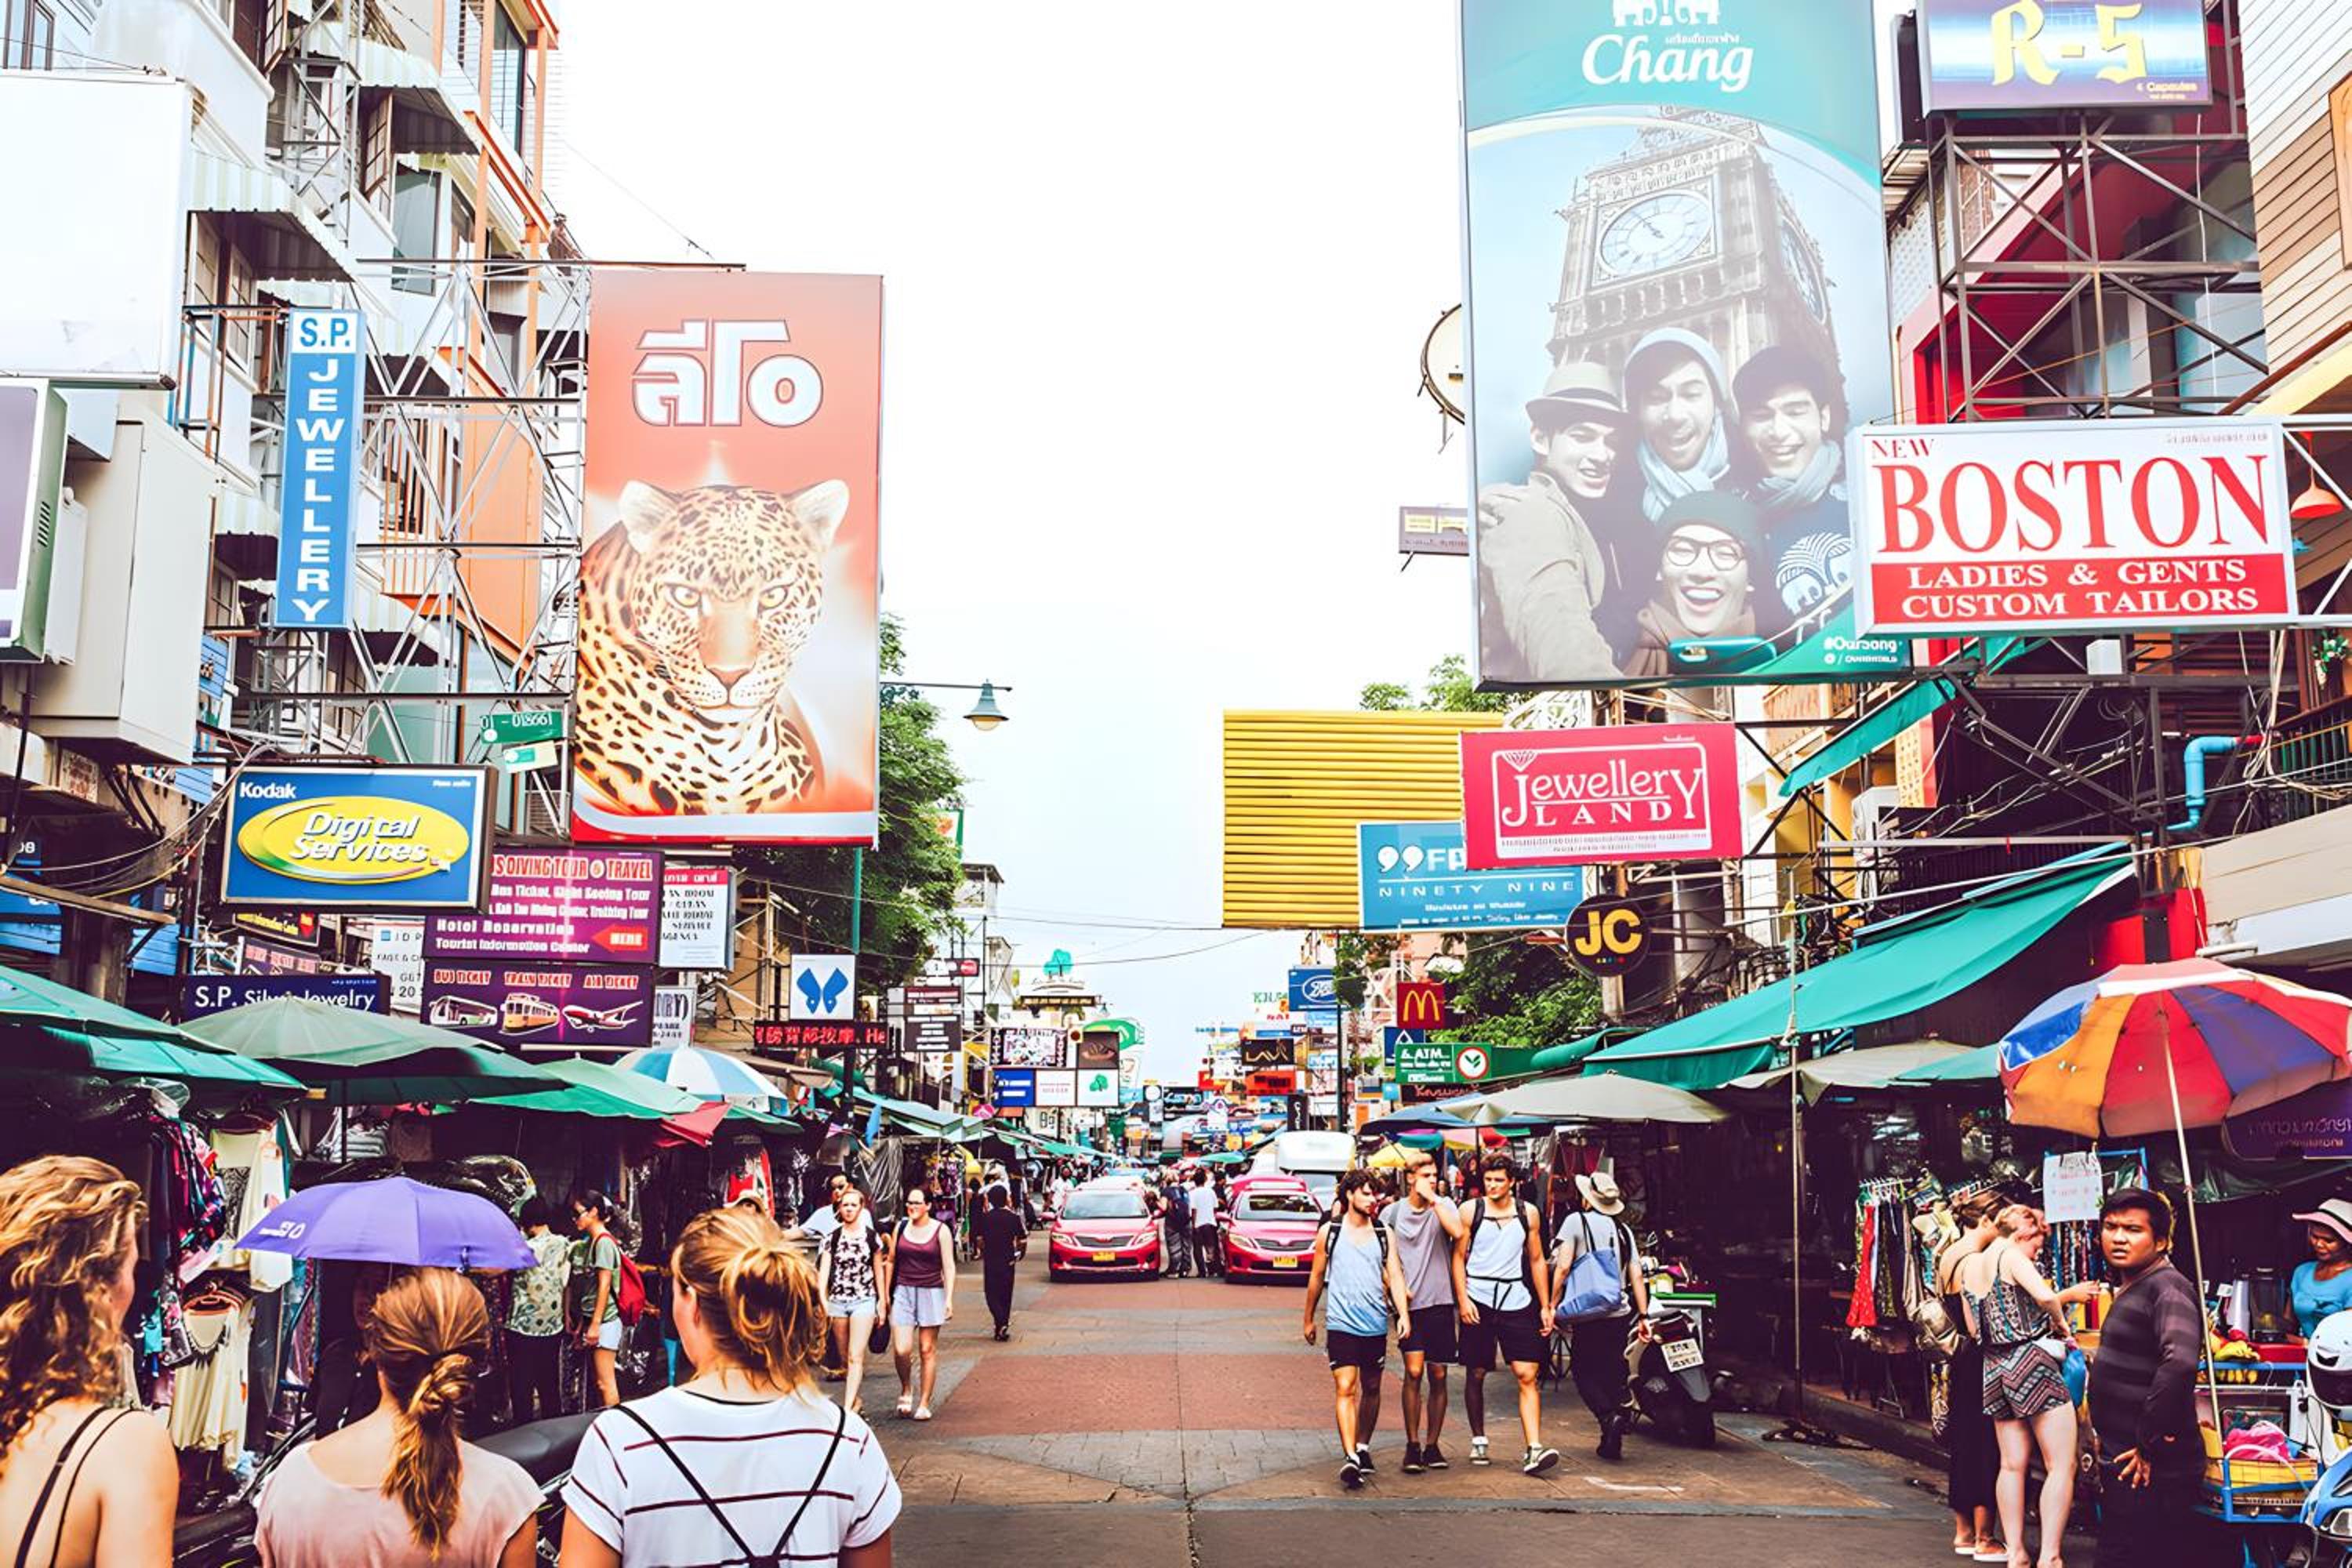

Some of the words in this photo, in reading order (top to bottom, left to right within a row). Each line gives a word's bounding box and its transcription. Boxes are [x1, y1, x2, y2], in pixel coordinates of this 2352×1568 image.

[1991, 0, 2148, 85] R-5
[1581, 34, 1755, 93] Chang
[299, 317, 350, 348] S.P.
[632, 319, 824, 427] ลีโอ
[1872, 437, 1934, 459] NEW
[291, 358, 345, 623] JEWELLERY
[1872, 454, 2270, 554] BOSTON
[1907, 564, 2049, 590] LADIES
[2067, 564, 2099, 585] &
[2117, 559, 2246, 584] GENTS
[1901, 592, 2068, 619] CUSTOM
[2085, 588, 2259, 615] TAILORS
[240, 782, 297, 799] Kodak
[303, 811, 421, 844] Digital
[289, 836, 430, 862] Services
[553, 858, 588, 879] TOUR
[606, 858, 653, 881] TRAVEL
[1380, 884, 1483, 898] NINETY
[1508, 880, 1574, 892] NINE
[437, 919, 477, 932] Hotel
[483, 920, 575, 935] Reservation
[1574, 909, 1642, 956] JC
[436, 938, 477, 949] Tourist
[479, 940, 547, 951] Information
[434, 968, 455, 984] BUS
[194, 985, 237, 1007] S.P.
